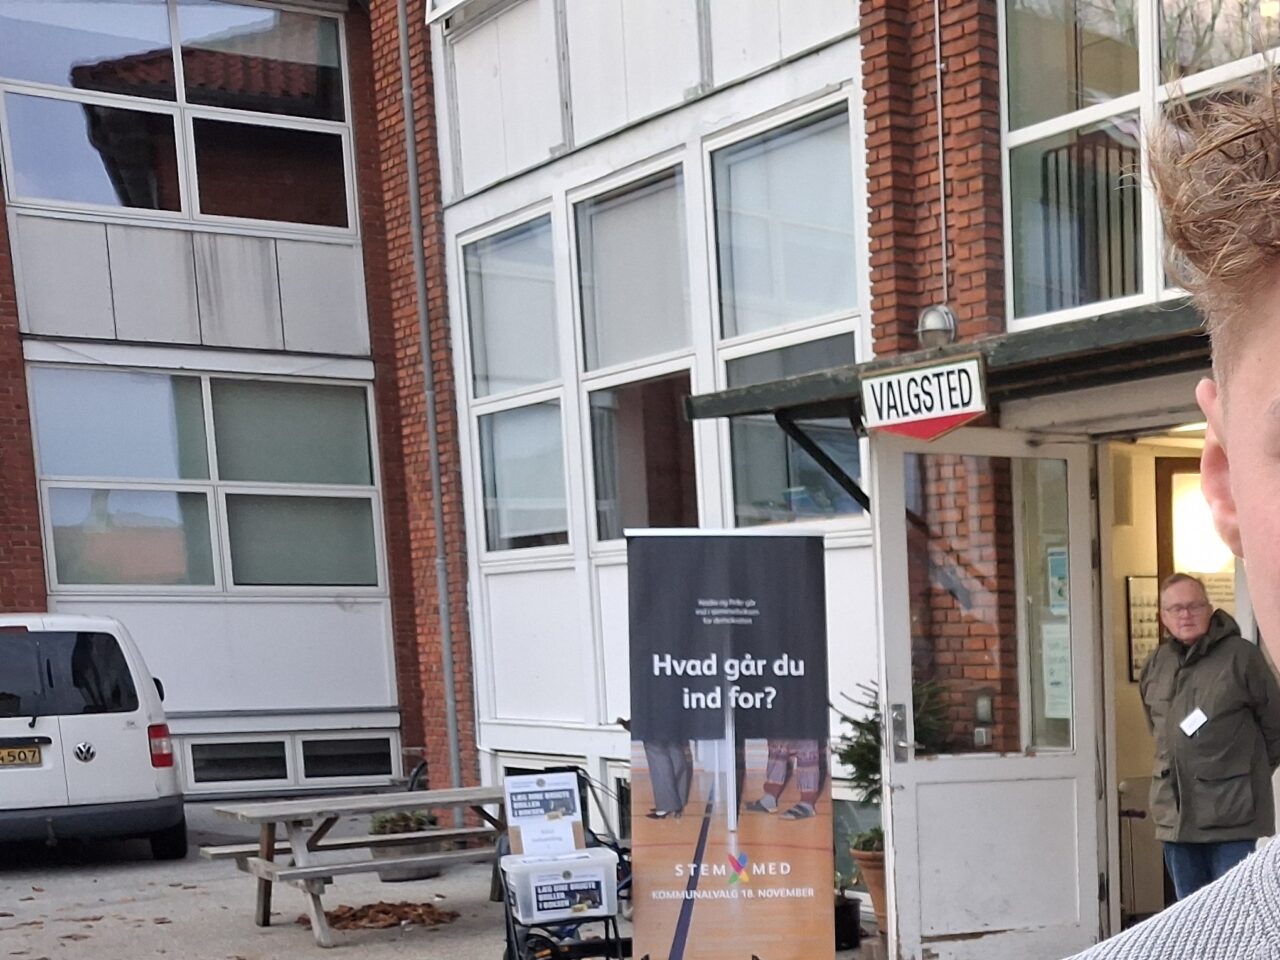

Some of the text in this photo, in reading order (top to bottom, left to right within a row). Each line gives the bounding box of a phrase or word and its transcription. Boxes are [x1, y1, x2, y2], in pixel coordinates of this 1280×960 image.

[871, 368, 972, 420] VALGSTED
[652, 653, 805, 681] Hvad går du
[683, 686, 777, 709] ind for?
[674, 863, 791, 877] STEM MED
[651, 888, 738, 900] KOMMUNALVALG
[758, 887, 815, 898] NOVEMBER
